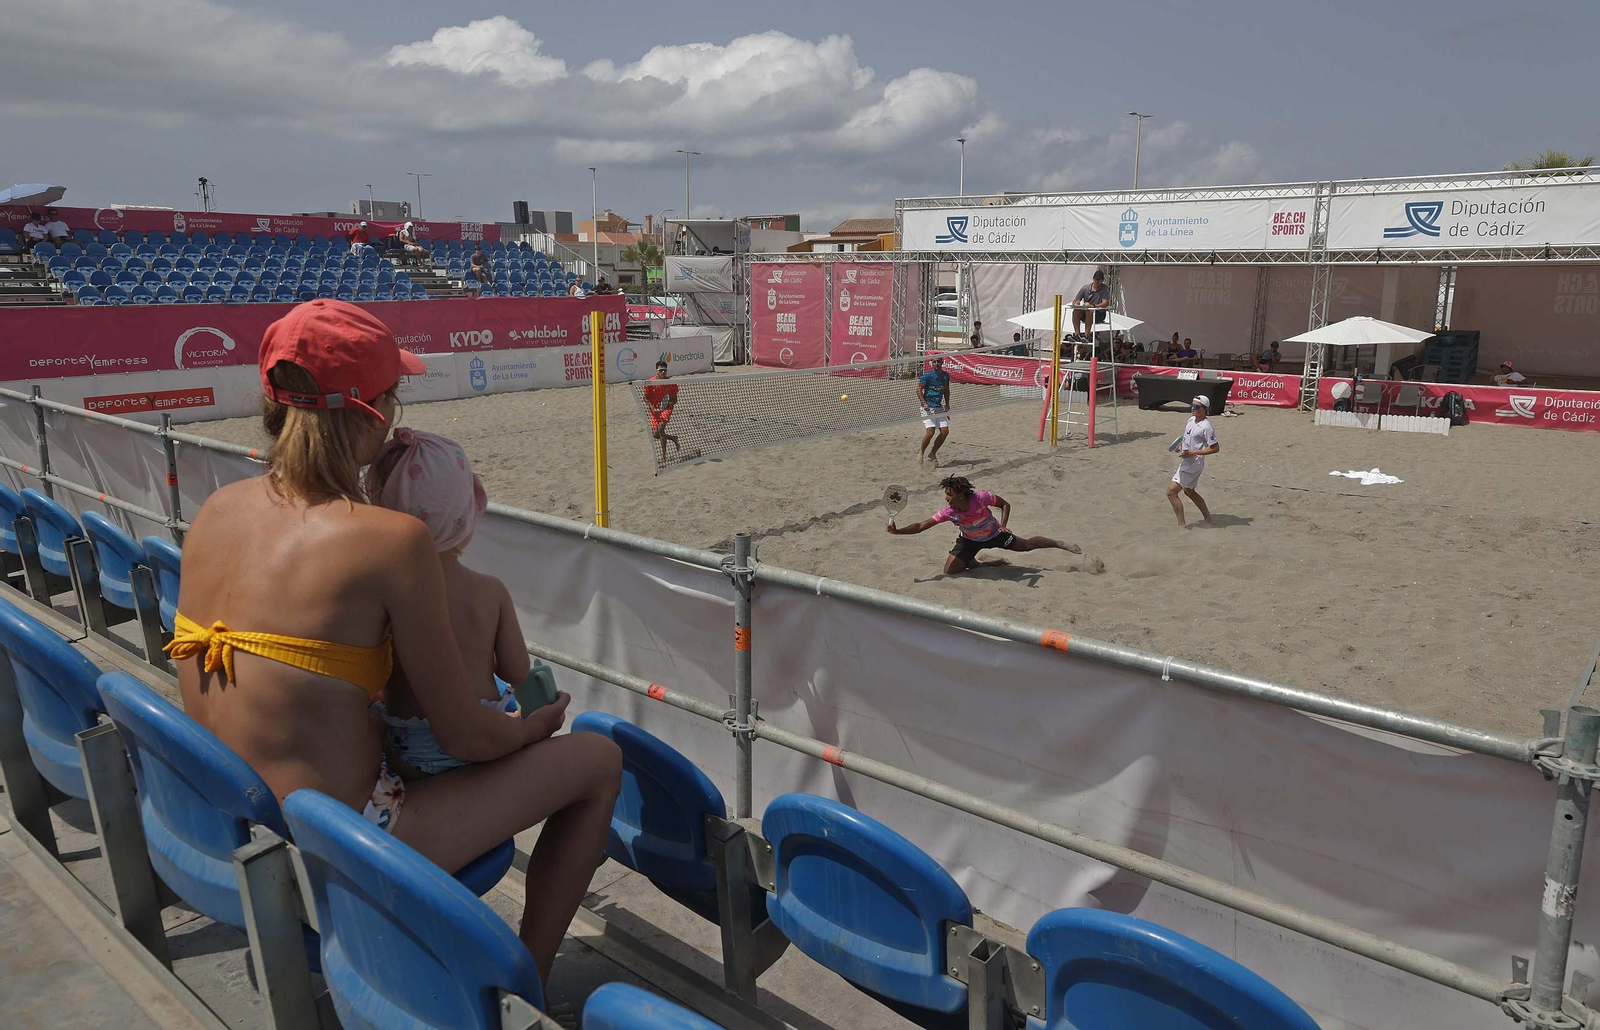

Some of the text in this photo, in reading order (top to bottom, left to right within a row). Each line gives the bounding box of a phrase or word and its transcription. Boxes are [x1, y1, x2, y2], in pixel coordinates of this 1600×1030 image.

[1451, 197, 1546, 218] Diputación
[189, 217, 223, 225] Ayuntamiento
[274, 218, 304, 228] Diputación
[972, 214, 1026, 231] Diputación
[1146, 215, 1209, 227] Ayuntamiento
[1273, 211, 1306, 225] BEACH
[283, 226, 299, 234] Cádiz
[461, 222, 483, 232] BEACH
[1145, 226, 1194, 238] de La Línea
[1272, 223, 1305, 237] SPORTS
[1448, 220, 1525, 237] de Cádiz
[461, 232, 483, 241] SPORTS
[972, 231, 1016, 245] de Cádiz
[777, 313, 796, 324] BEACH
[849, 315, 873, 328] BEACH
[521, 325, 567, 340] volabola
[777, 323, 796, 333] SPORTS
[848, 326, 873, 338] SPORTS
[394, 332, 432, 345] iputación
[449, 329, 493, 348] KYDO
[186, 348, 228, 359] VICTORIA
[563, 351, 593, 369] BEACH
[672, 350, 705, 364] Iberdrola
[491, 361, 537, 374] Ayuntamiento
[492, 371, 529, 383] de La Línea
[1238, 379, 1284, 391] Diputación
[1237, 389, 1275, 402] de Cádiz
[1543, 410, 1596, 423] de Cádiz
